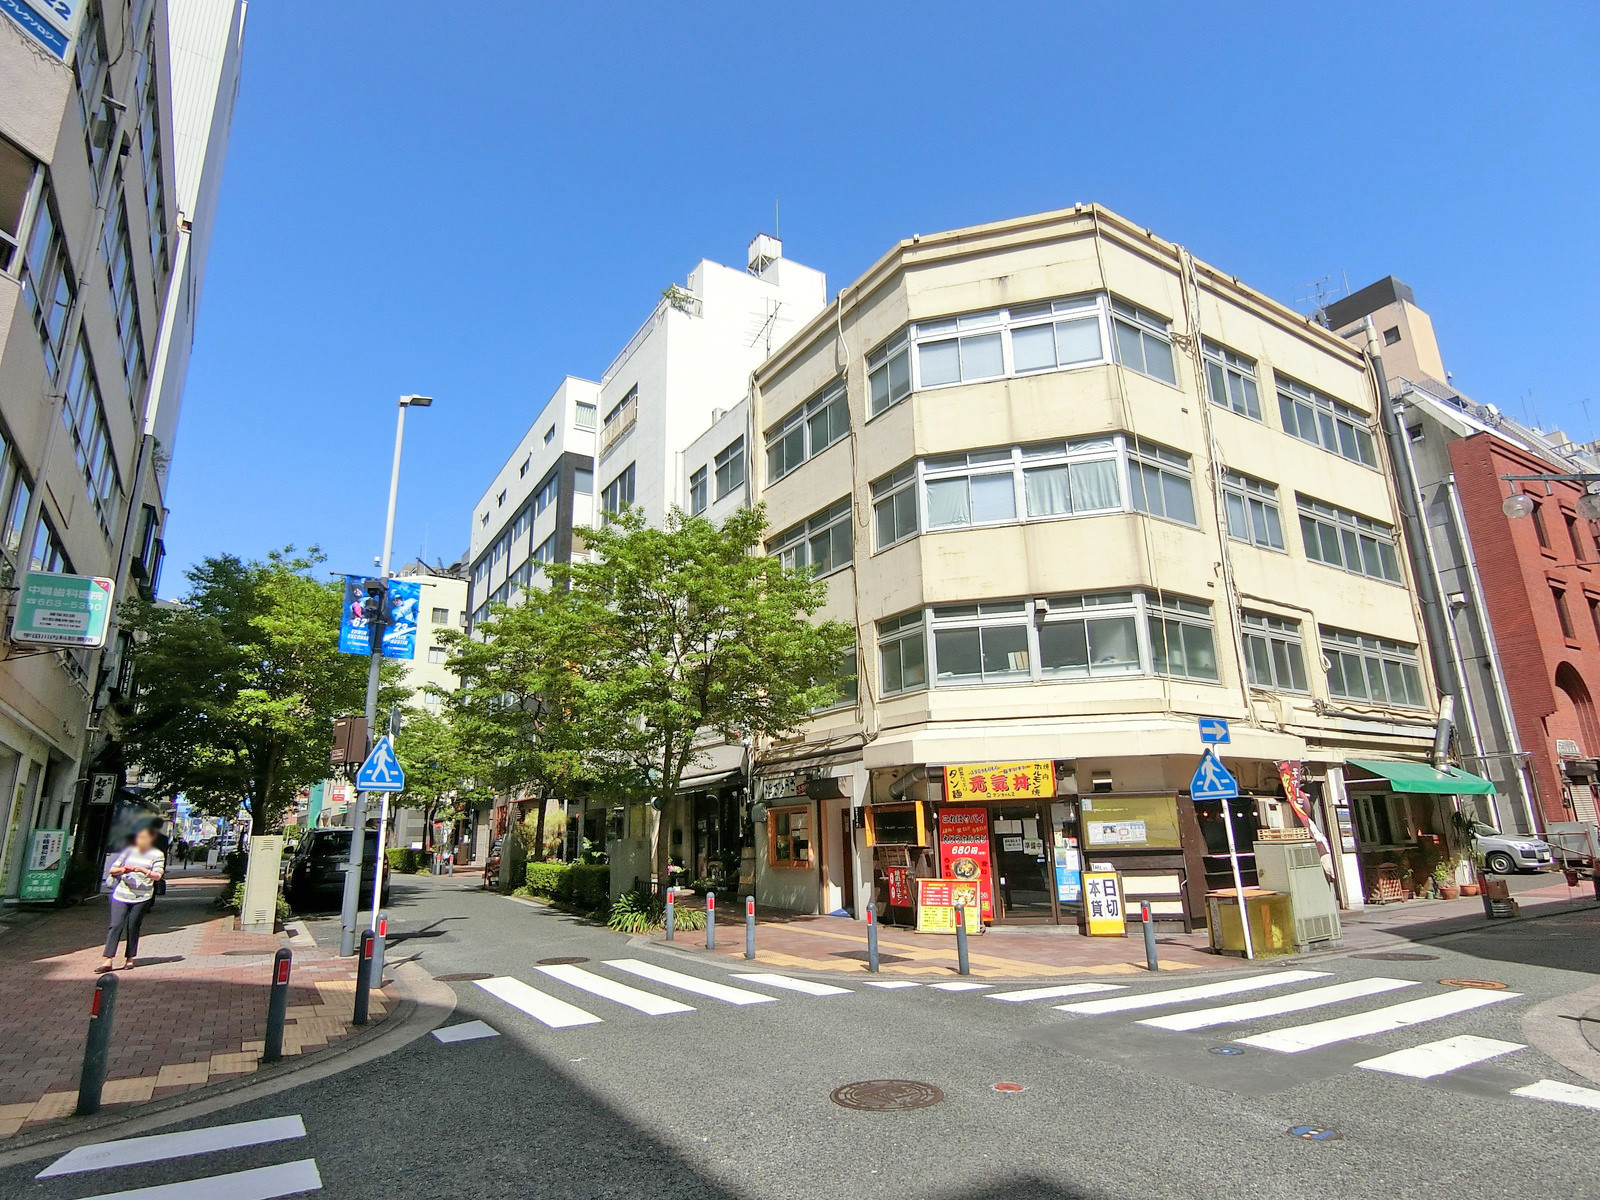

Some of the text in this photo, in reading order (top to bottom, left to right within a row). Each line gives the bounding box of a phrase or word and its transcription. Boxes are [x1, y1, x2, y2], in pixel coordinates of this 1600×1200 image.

[353, 618, 368, 628] 62
[948, 769, 963, 800] タン麺
[969, 773, 1032, 793] 元気丼
[1024, 841, 1042, 850] 準備中
[27, 872, 57, 880] インプラント
[1088, 879, 1117, 898] 本日
[1091, 899, 1119, 918] 貸切
